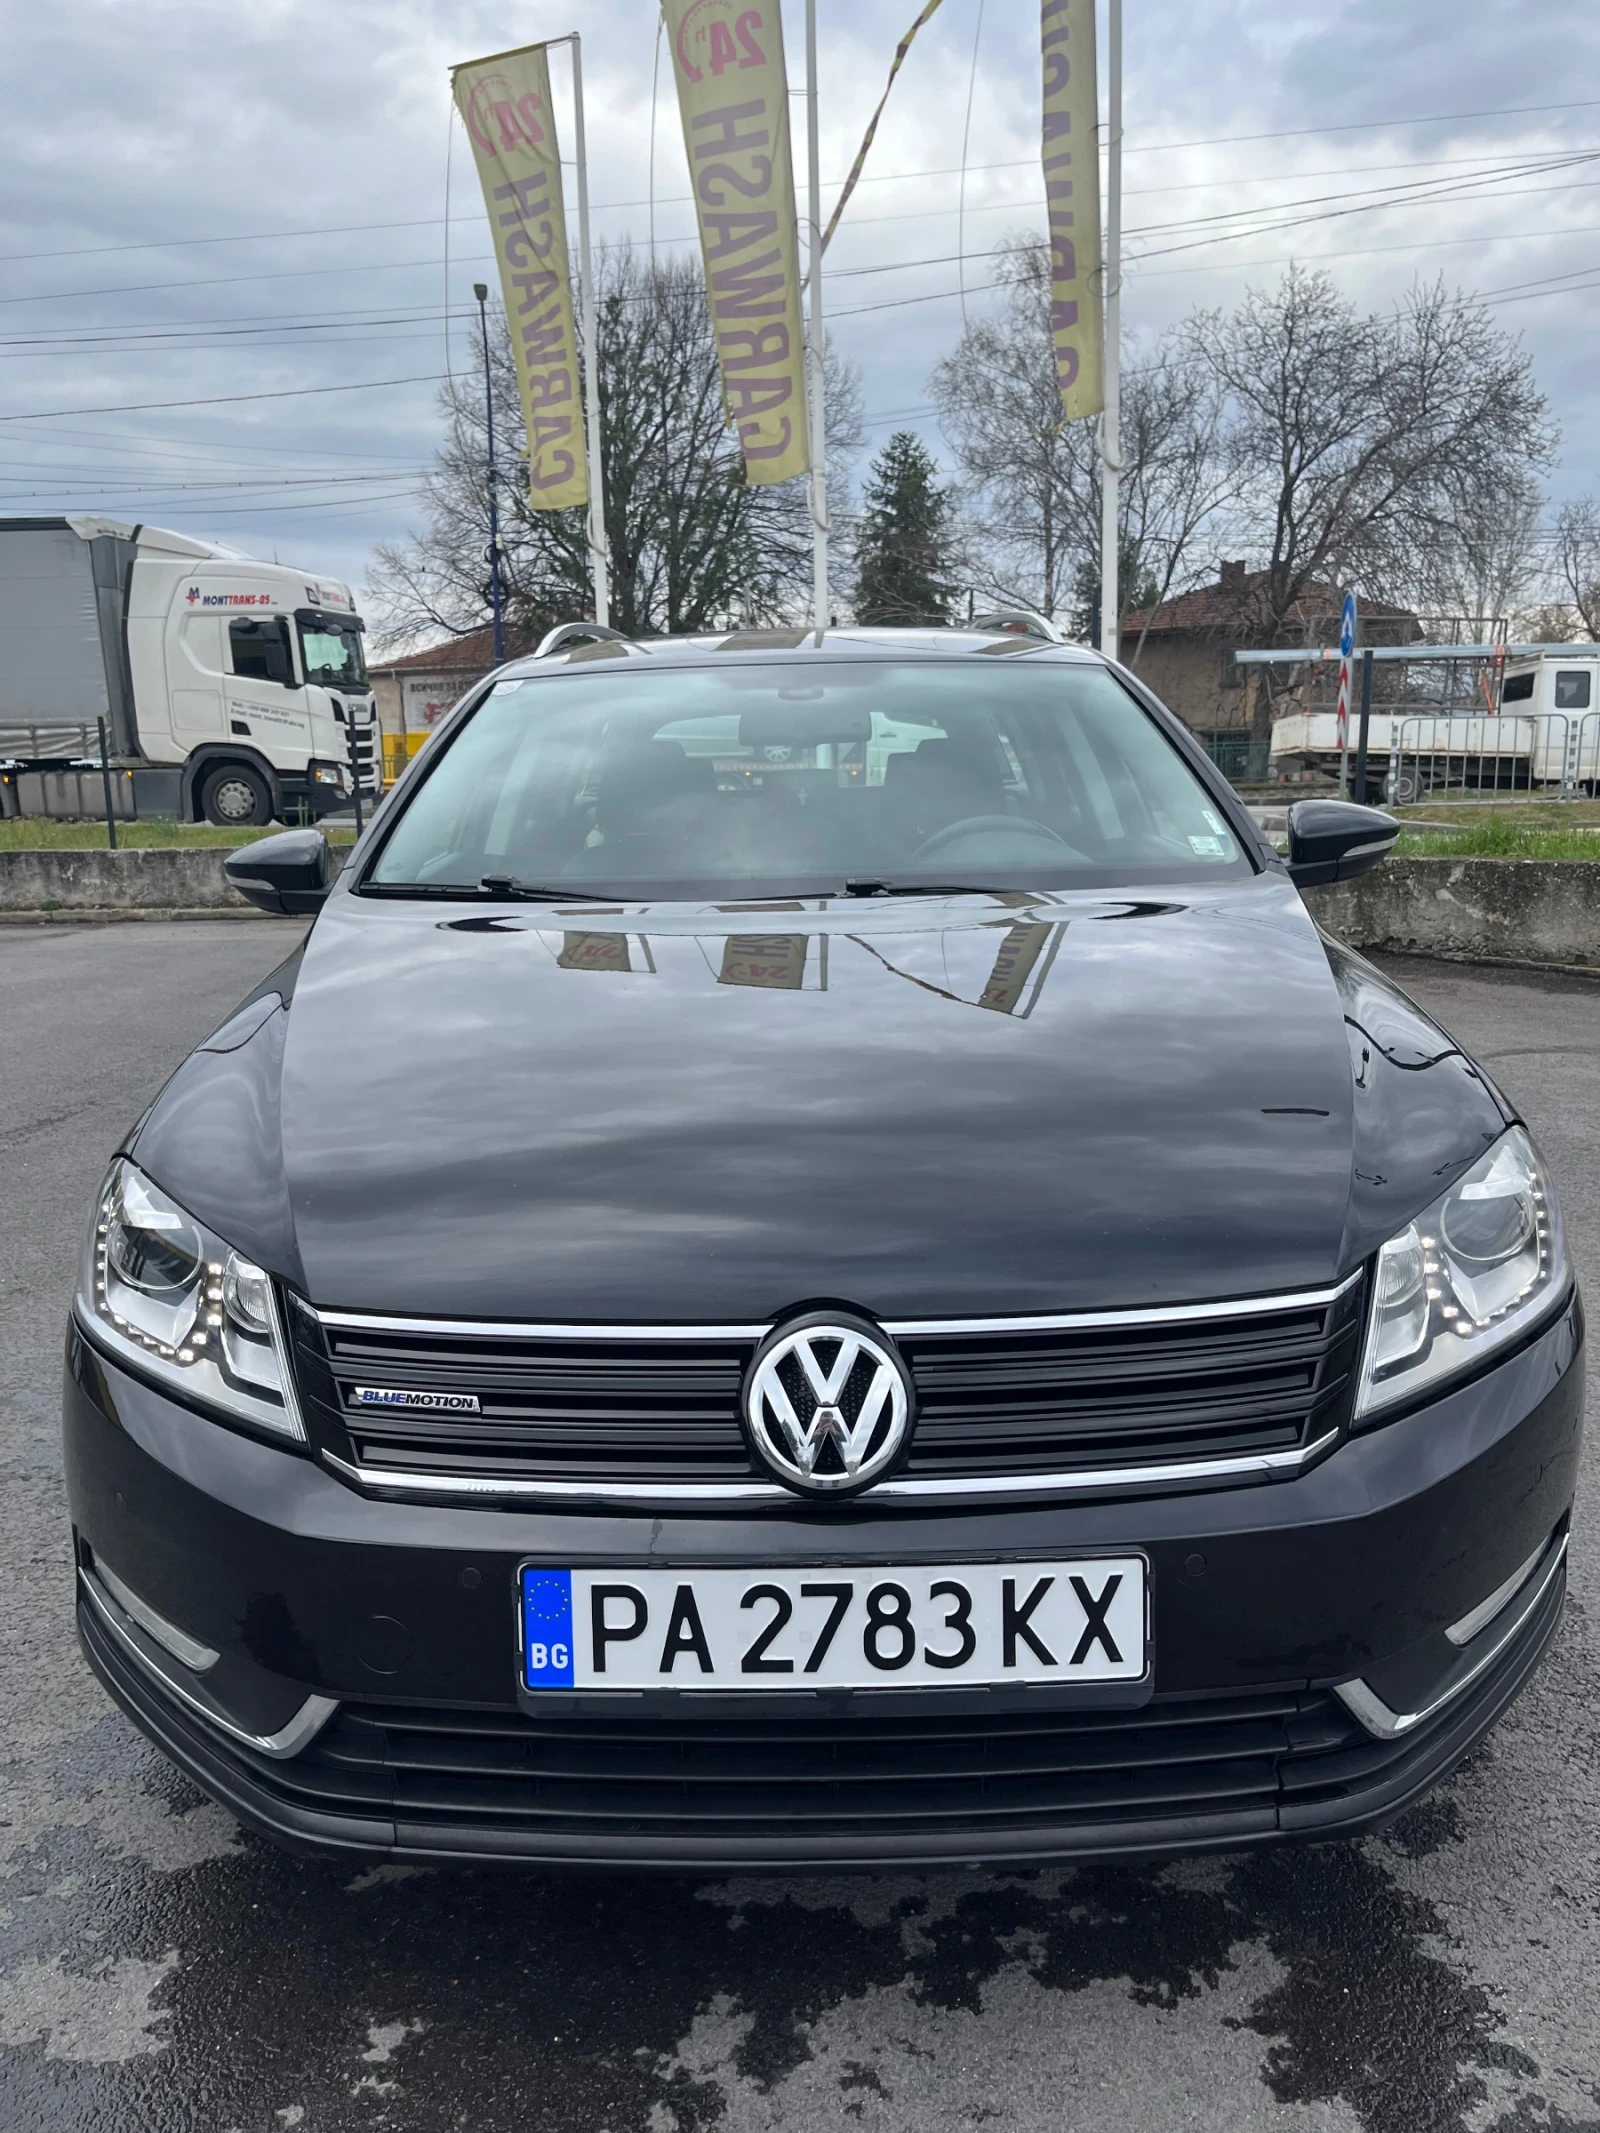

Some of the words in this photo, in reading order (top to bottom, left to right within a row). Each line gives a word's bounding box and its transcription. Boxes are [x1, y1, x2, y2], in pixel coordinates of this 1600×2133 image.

[362, 1390, 474, 1409] BLUEMOTION
[590, 1584, 715, 1674] PA
[739, 1580, 977, 1674] 2783
[1001, 1574, 1125, 1668] KX
[531, 1643, 569, 1670] BG
